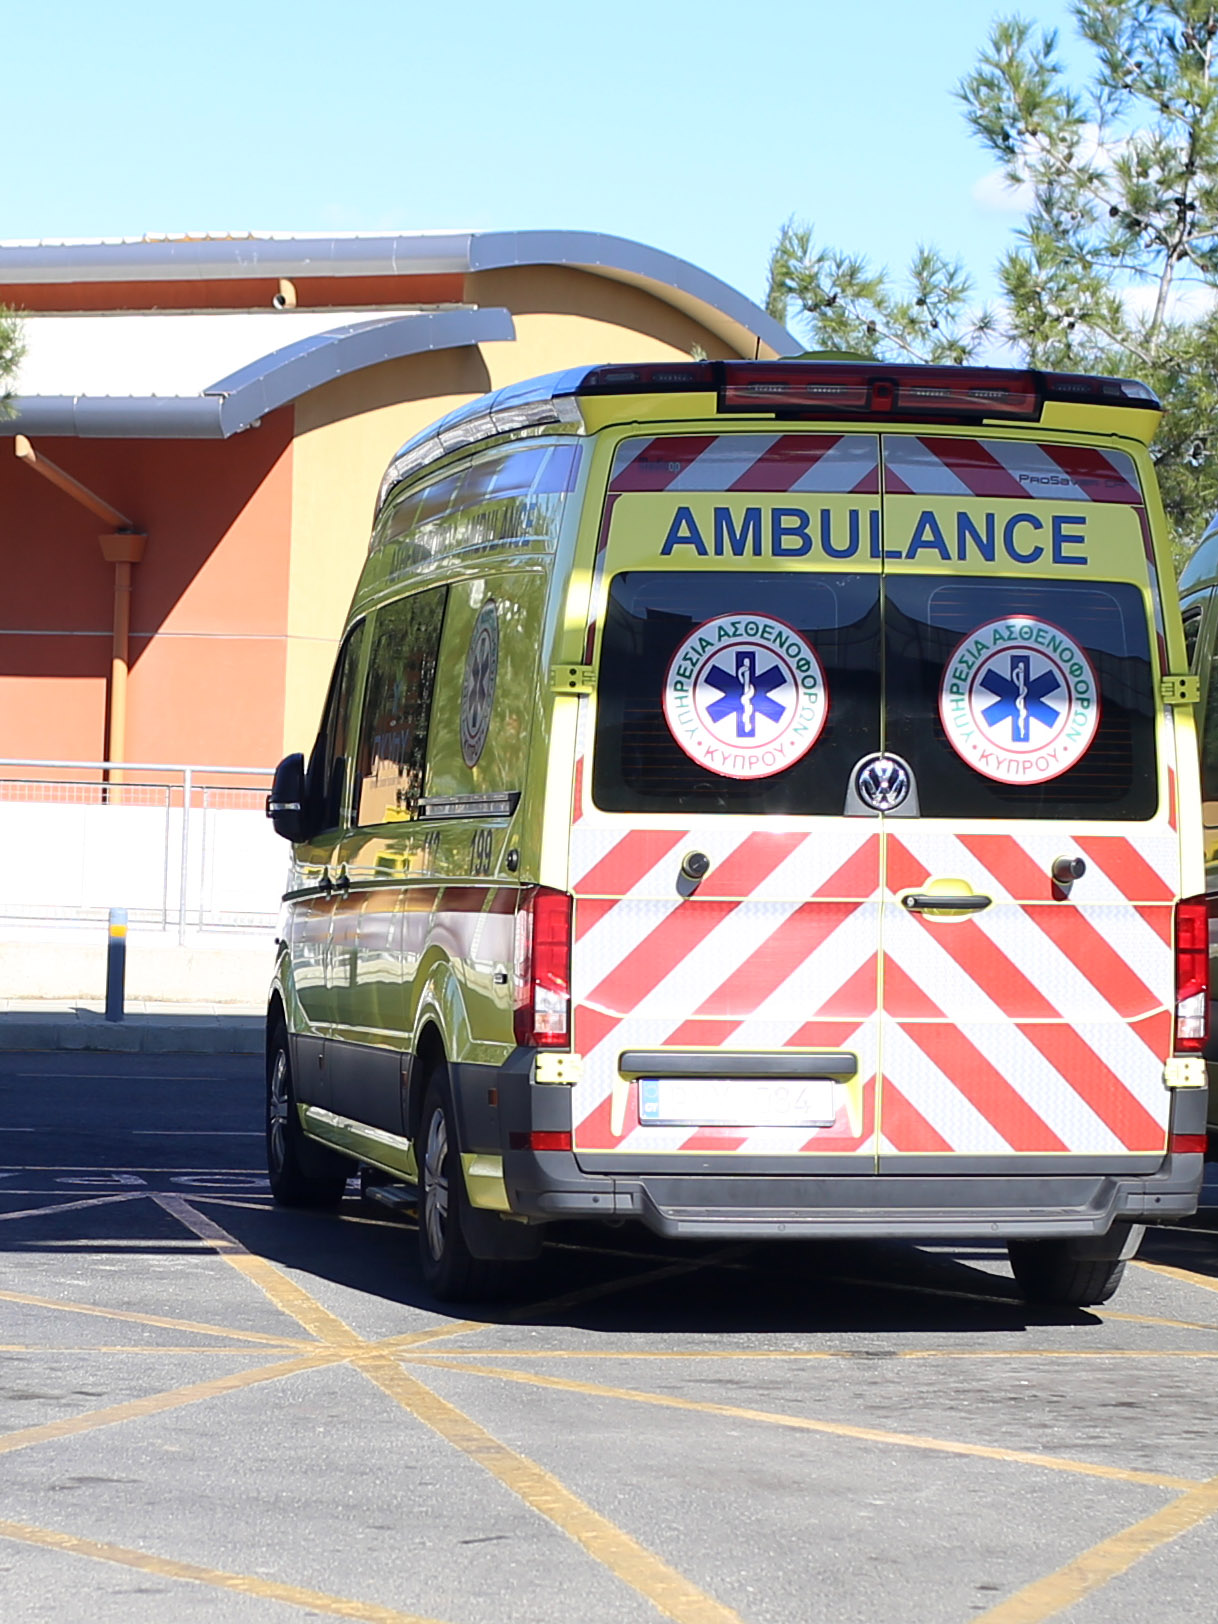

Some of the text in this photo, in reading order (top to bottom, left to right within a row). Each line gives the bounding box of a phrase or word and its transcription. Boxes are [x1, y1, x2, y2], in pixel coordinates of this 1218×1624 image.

[660, 506, 1089, 566] AMBULANCE
[673, 620, 818, 740] ΥΠΗΡΕΣΙΑ ΑΣΘΕΝΟΦΟΡΩΝ
[949, 624, 1091, 744] ΥΠΗΡΕΣΙΑ ΑΣΘΕΝΟΦΟΡΩΝ
[703, 742, 788, 770] ΚΥΠΡΟΥ
[978, 748, 1060, 775] ΚΥΠΡΟΥ
[469, 827, 493, 876] 199
